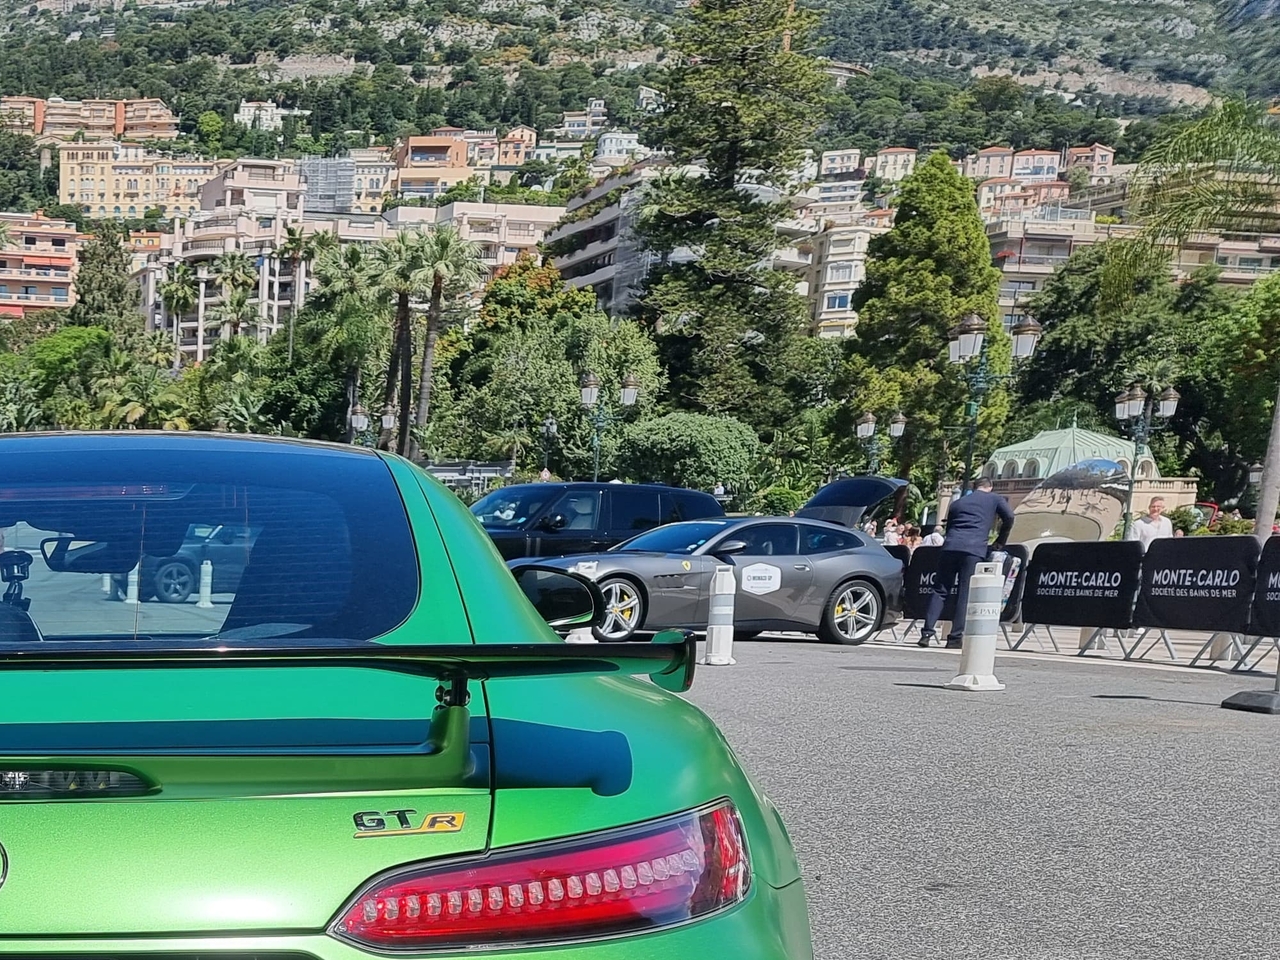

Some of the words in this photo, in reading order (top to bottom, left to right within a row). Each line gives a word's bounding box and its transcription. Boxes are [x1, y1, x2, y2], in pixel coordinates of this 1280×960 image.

[1063, 588, 1075, 597] DES
[1075, 589, 1094, 597] BAINS
[1094, 589, 1104, 597] DE
[1104, 589, 1119, 598] MER
[1176, 588, 1188, 597] DES
[1189, 588, 1209, 598] BAINS
[1210, 589, 1220, 598] DE
[1222, 589, 1237, 598] MER
